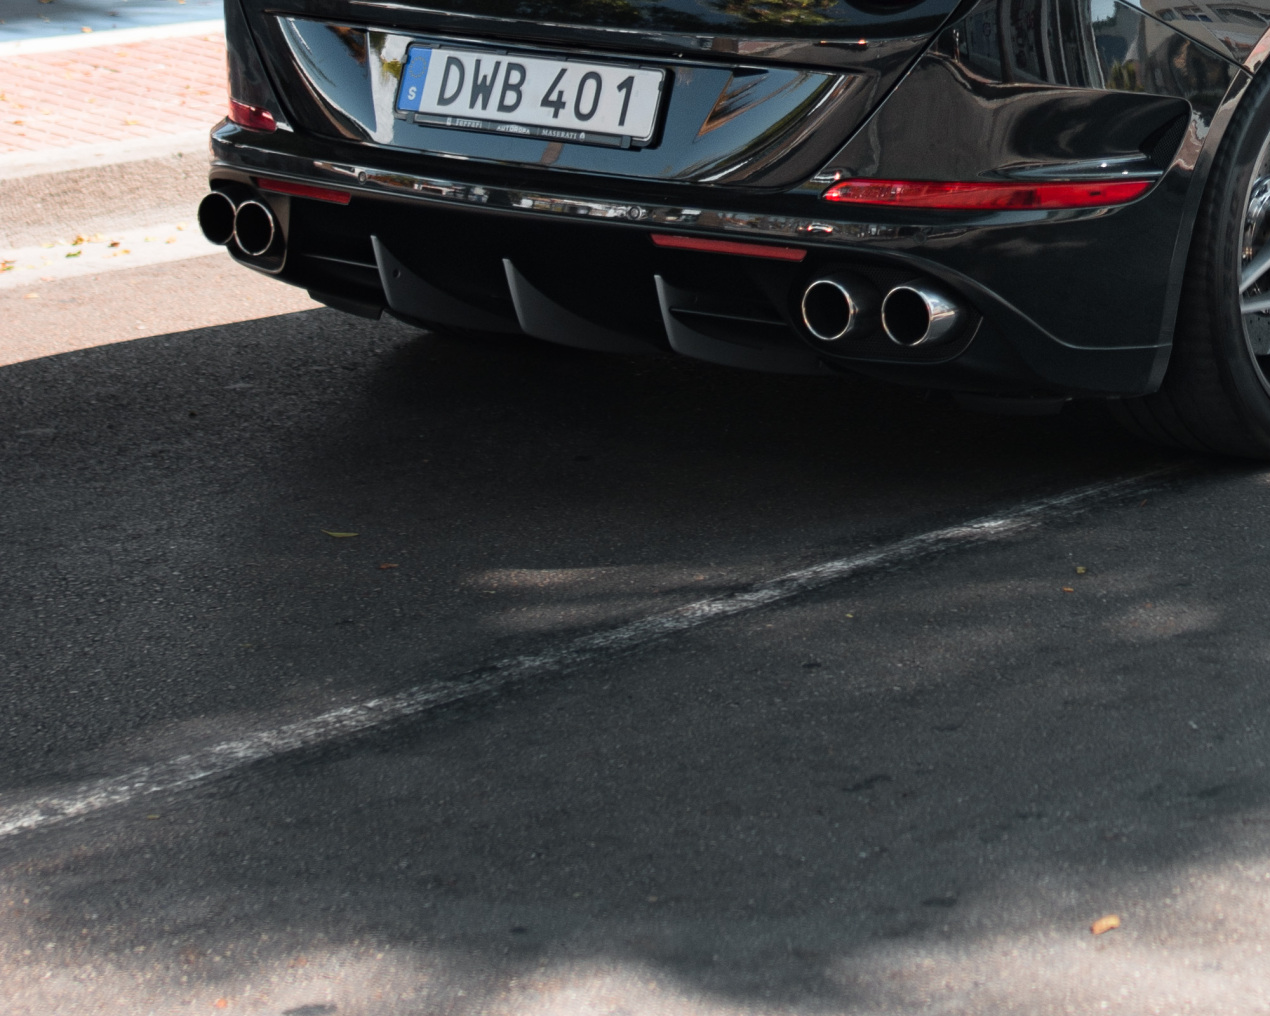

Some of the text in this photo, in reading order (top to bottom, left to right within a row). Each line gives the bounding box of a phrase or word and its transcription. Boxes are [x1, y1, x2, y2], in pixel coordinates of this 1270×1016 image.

[407, 86, 418, 101] S
[436, 56, 635, 127] DWB 401
[542, 129, 578, 140] MASERATI
